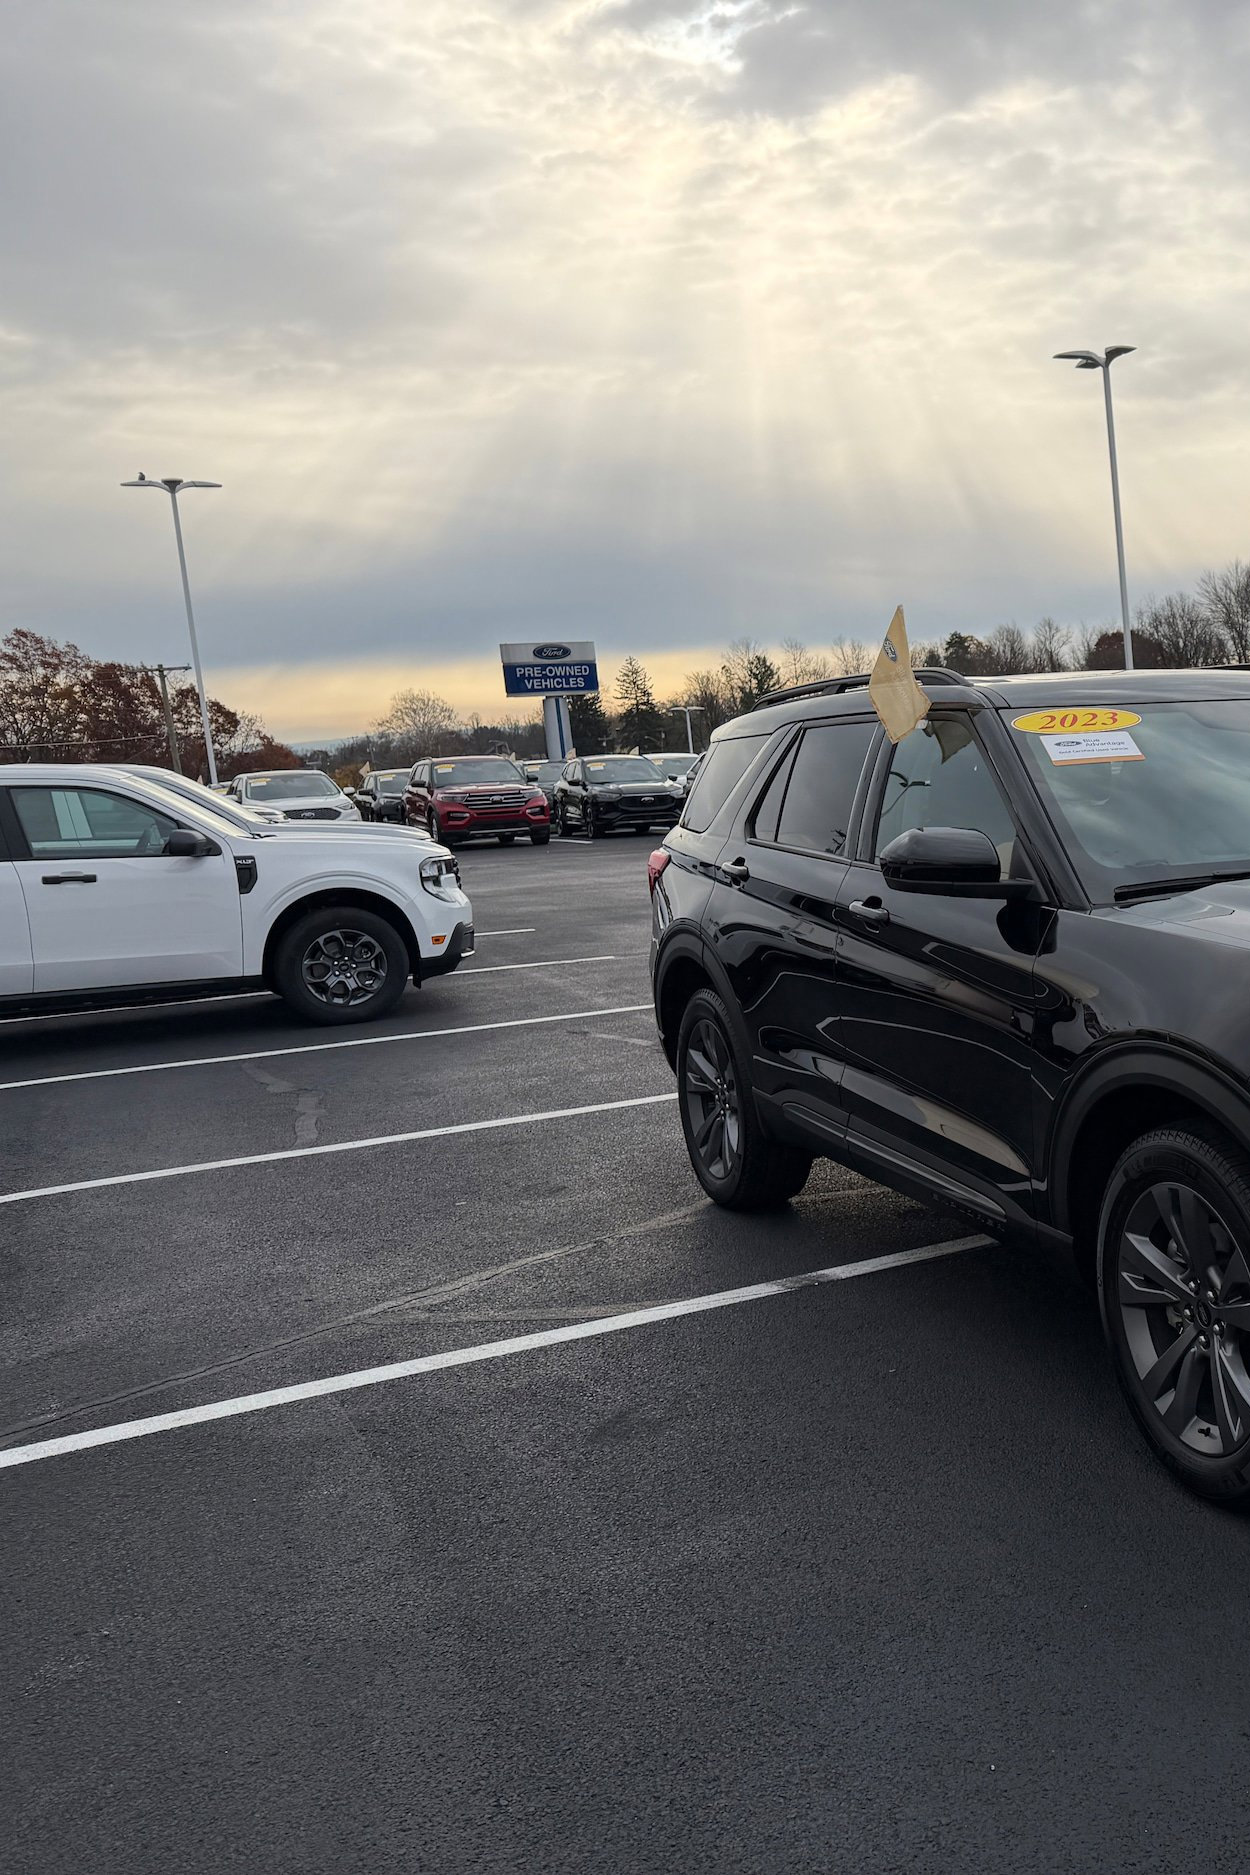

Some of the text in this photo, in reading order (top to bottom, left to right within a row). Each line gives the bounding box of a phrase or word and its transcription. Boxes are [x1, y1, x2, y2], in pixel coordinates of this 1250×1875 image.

[516, 665, 590, 678] PRE-OWNED
[524, 678, 585, 689] VEHICLES
[1039, 711, 1119, 730] 2023
